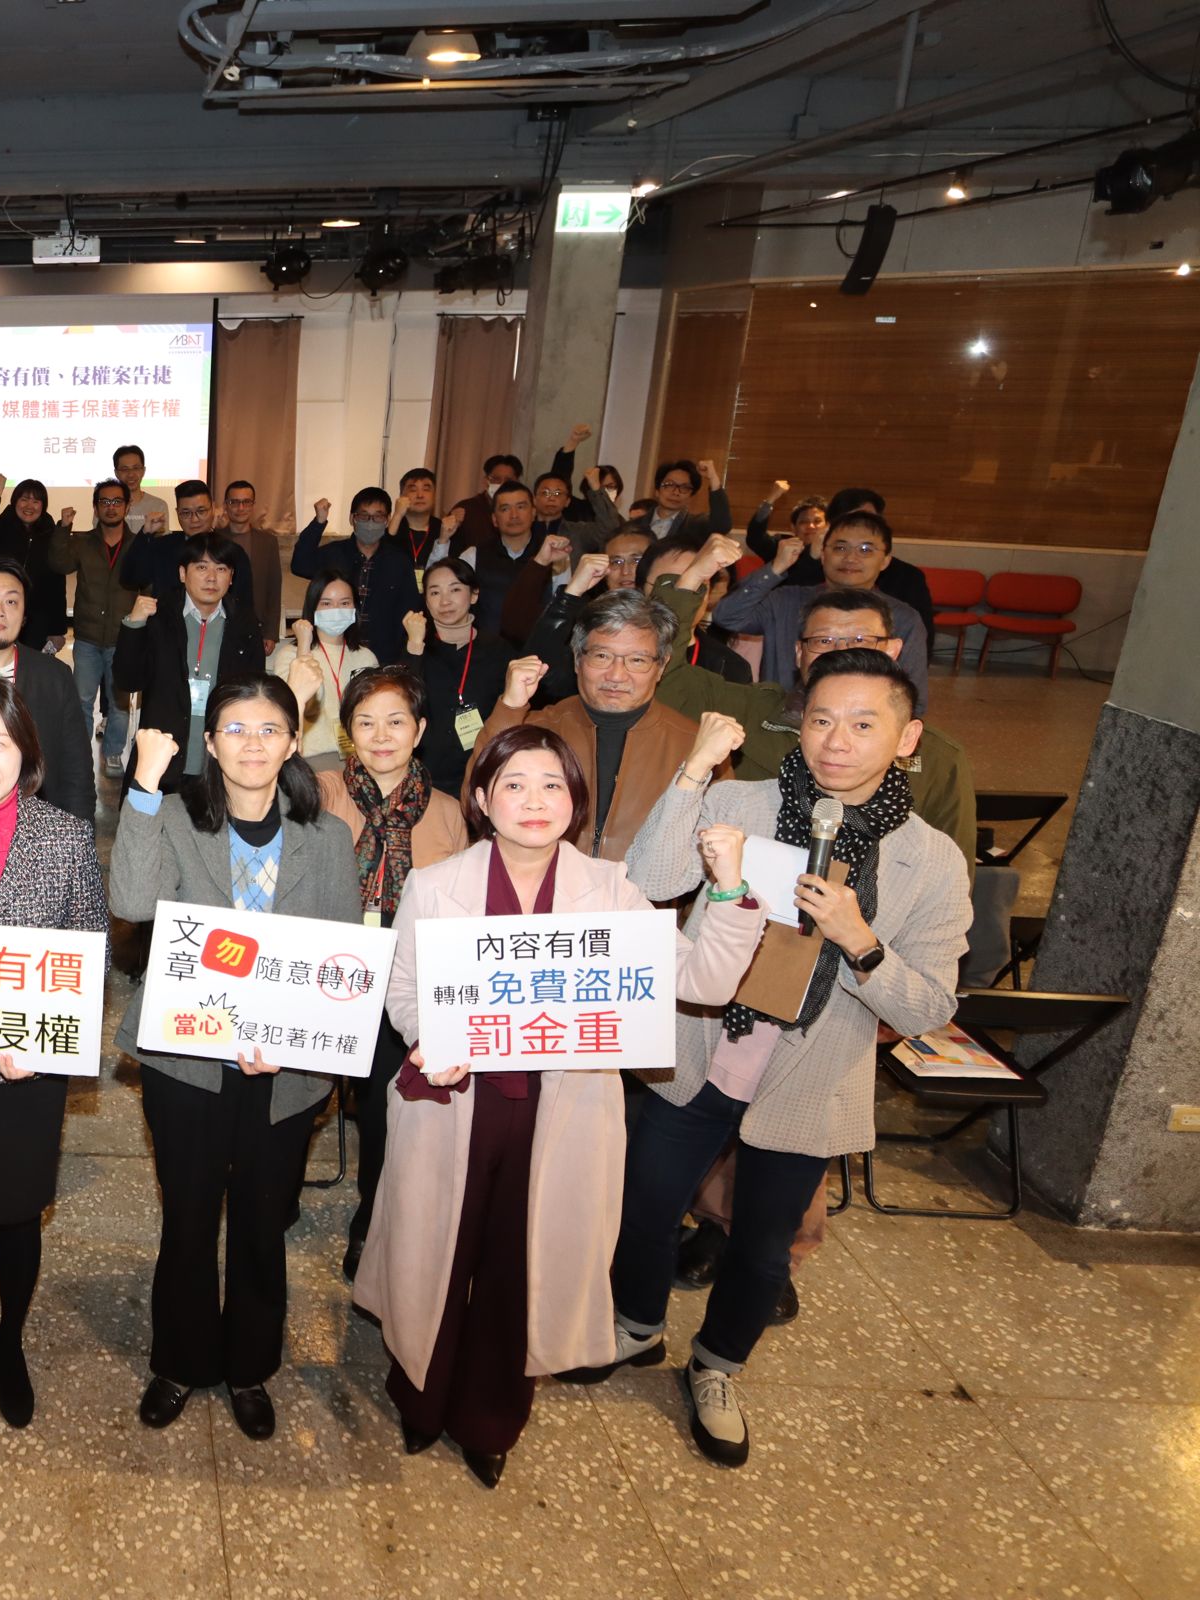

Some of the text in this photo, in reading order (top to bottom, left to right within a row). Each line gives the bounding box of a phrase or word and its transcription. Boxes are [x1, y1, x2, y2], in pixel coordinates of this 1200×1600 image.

[169, 334, 202, 346] MBAT
[43, 436, 97, 454] 記者會
[164, 915, 205, 982] 文章
[476, 928, 612, 961] 內容有價
[433, 966, 656, 1006] 轉傳 免費盜版
[174, 1013, 359, 1055] 當心 侵犯著作權
[466, 1010, 623, 1057] 罰金重
